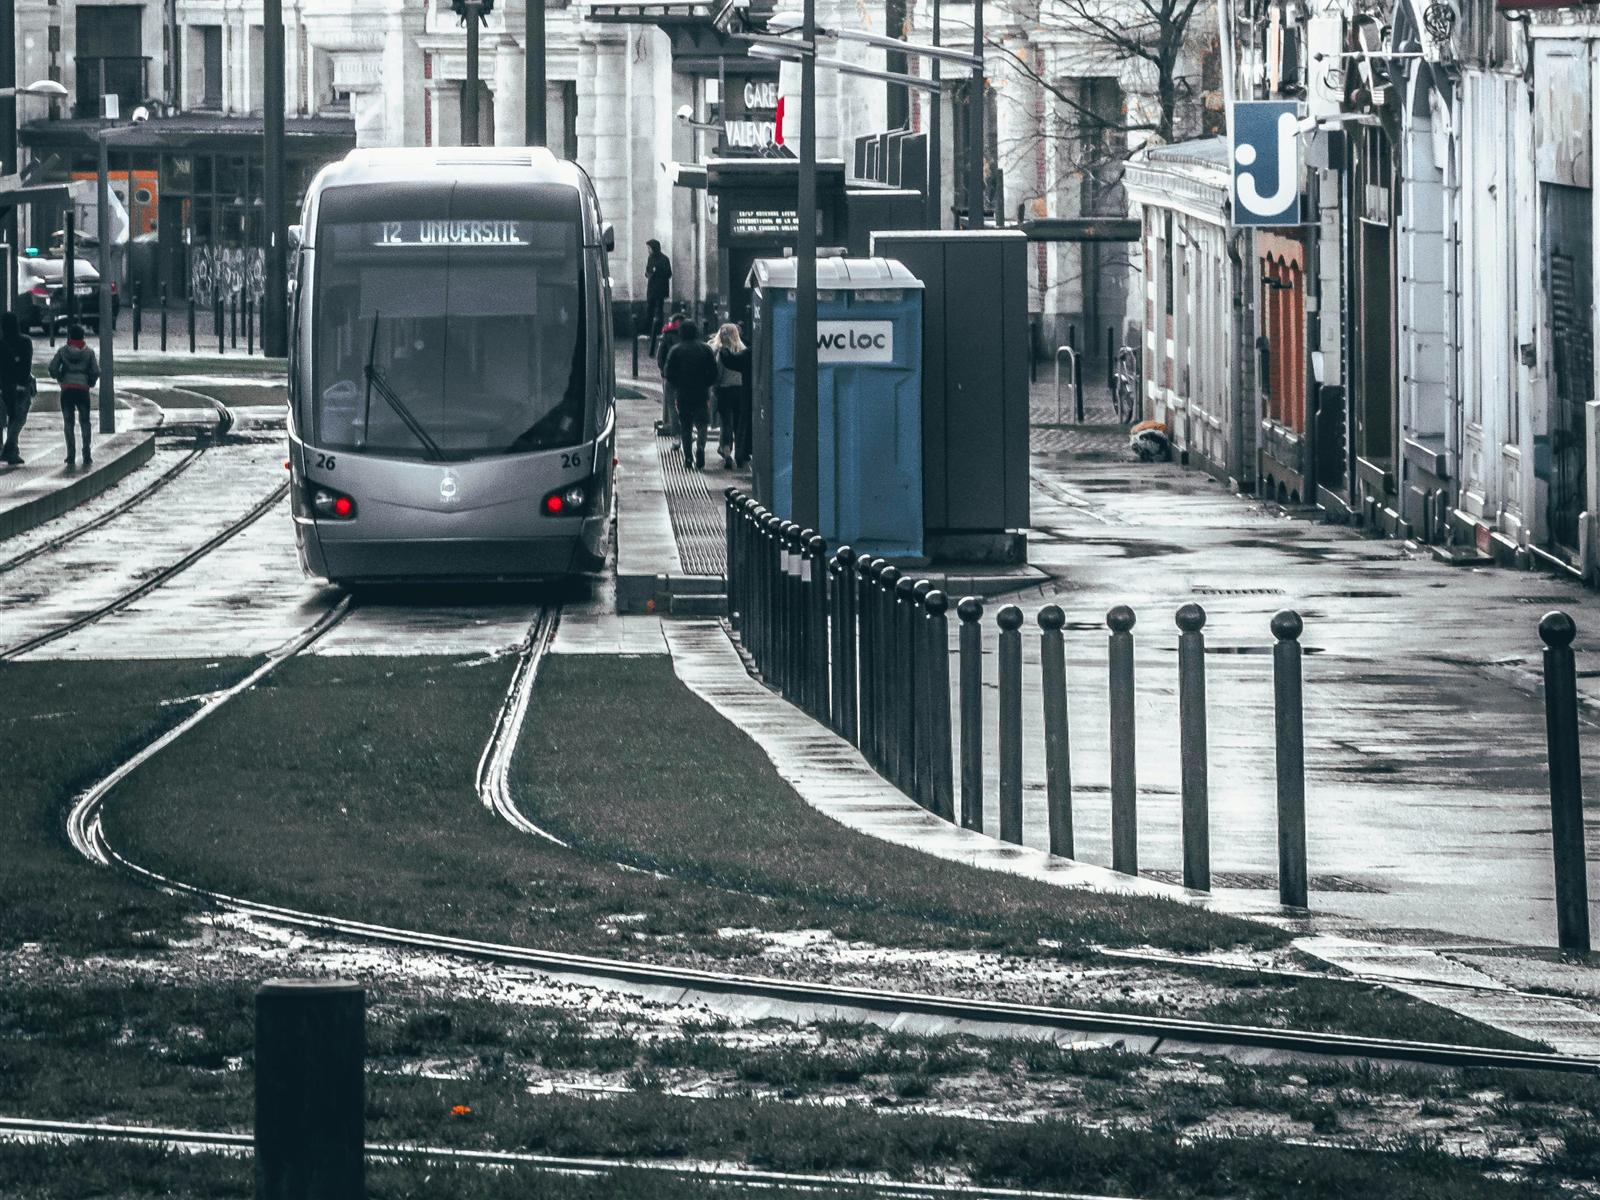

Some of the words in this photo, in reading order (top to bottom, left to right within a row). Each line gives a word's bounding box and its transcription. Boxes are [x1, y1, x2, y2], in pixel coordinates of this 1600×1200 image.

[744, 82, 777, 108] GARE
[420, 220, 520, 242] UNIVERSITE
[316, 453, 336, 470] 26
[560, 453, 580, 468] 26
